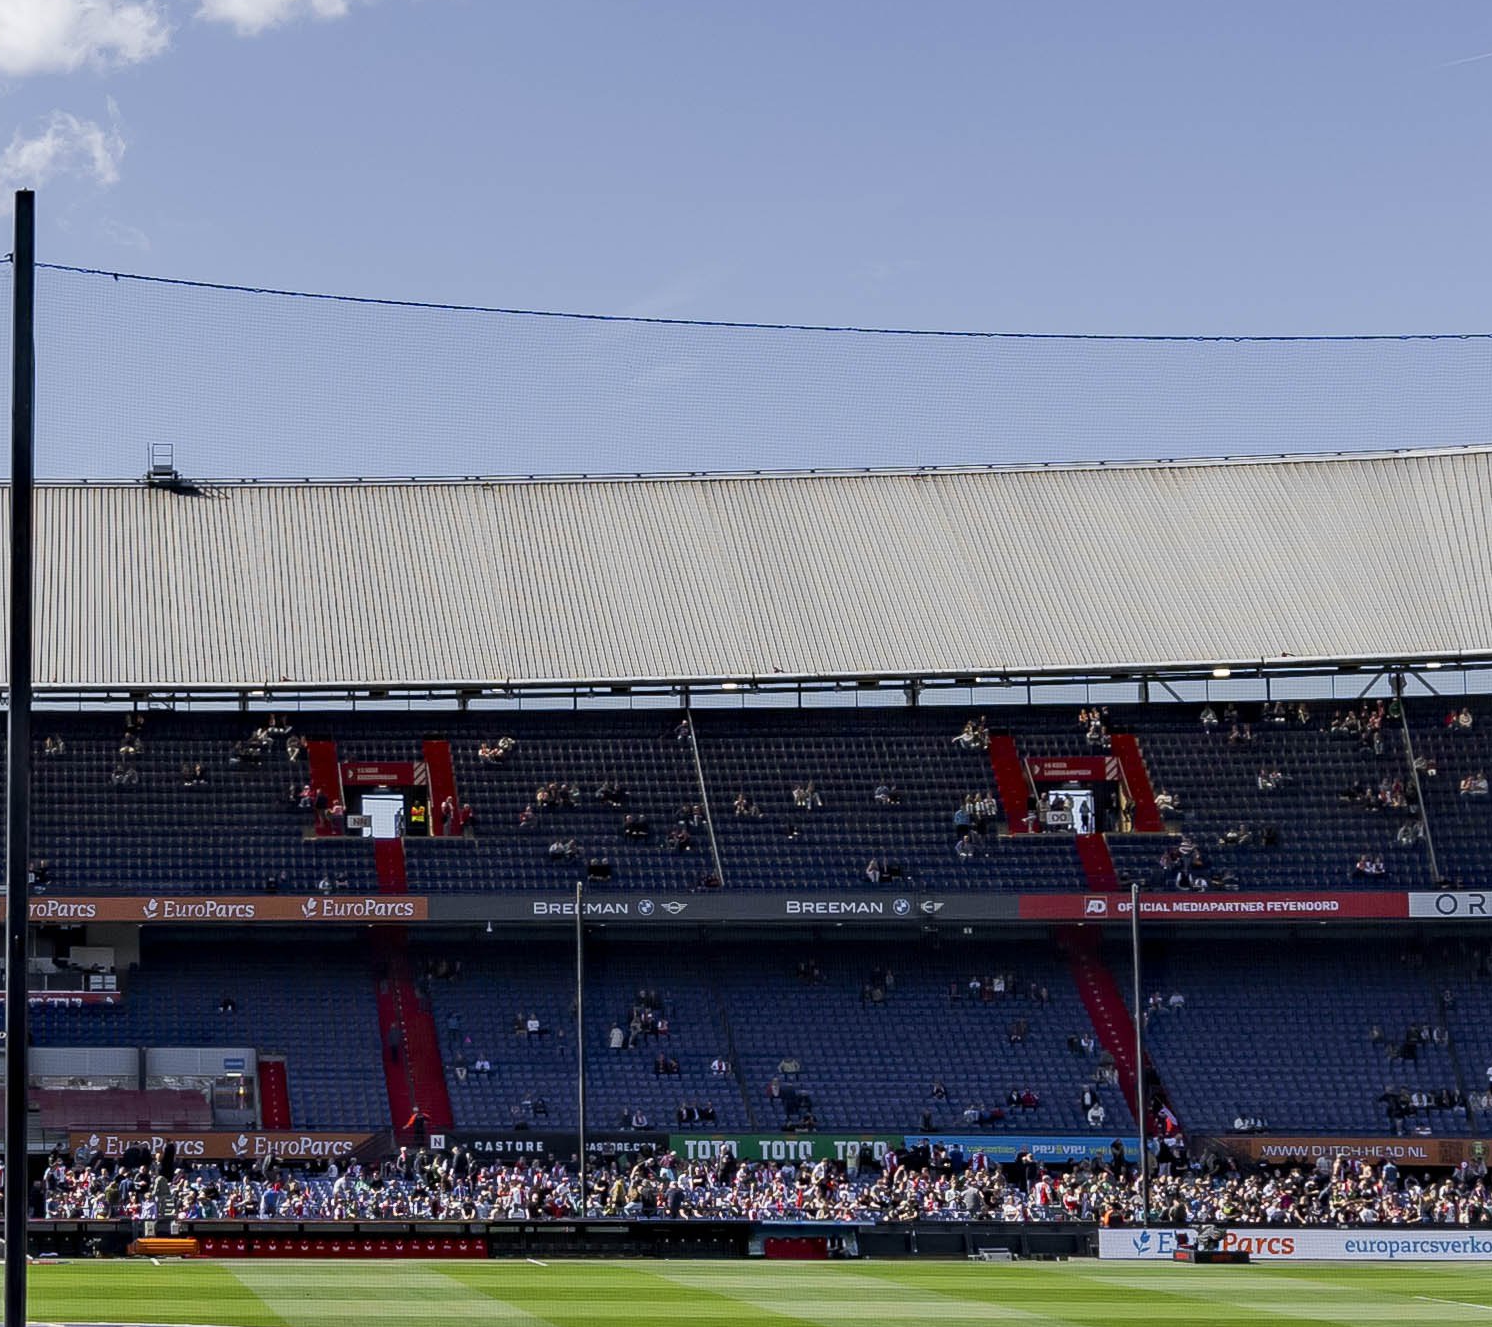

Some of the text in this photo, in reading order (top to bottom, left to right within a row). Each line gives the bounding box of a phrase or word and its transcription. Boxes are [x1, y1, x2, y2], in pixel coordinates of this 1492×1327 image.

[28, 900, 96, 918] roParcs
[162, 899, 255, 919] EuroParcs
[321, 898, 414, 919] EuroParcs
[786, 900, 883, 915] BREEMAN
[1086, 900, 1107, 913] AD
[1117, 901, 1339, 913] OFICIAL MEDIAPARTNER FEYENOORD
[433, 1137, 442, 1146] N
[474, 1140, 544, 1152] CASTORE
[758, 1139, 813, 1160] TOTO
[1156, 1231, 1295, 1255] EParcs
